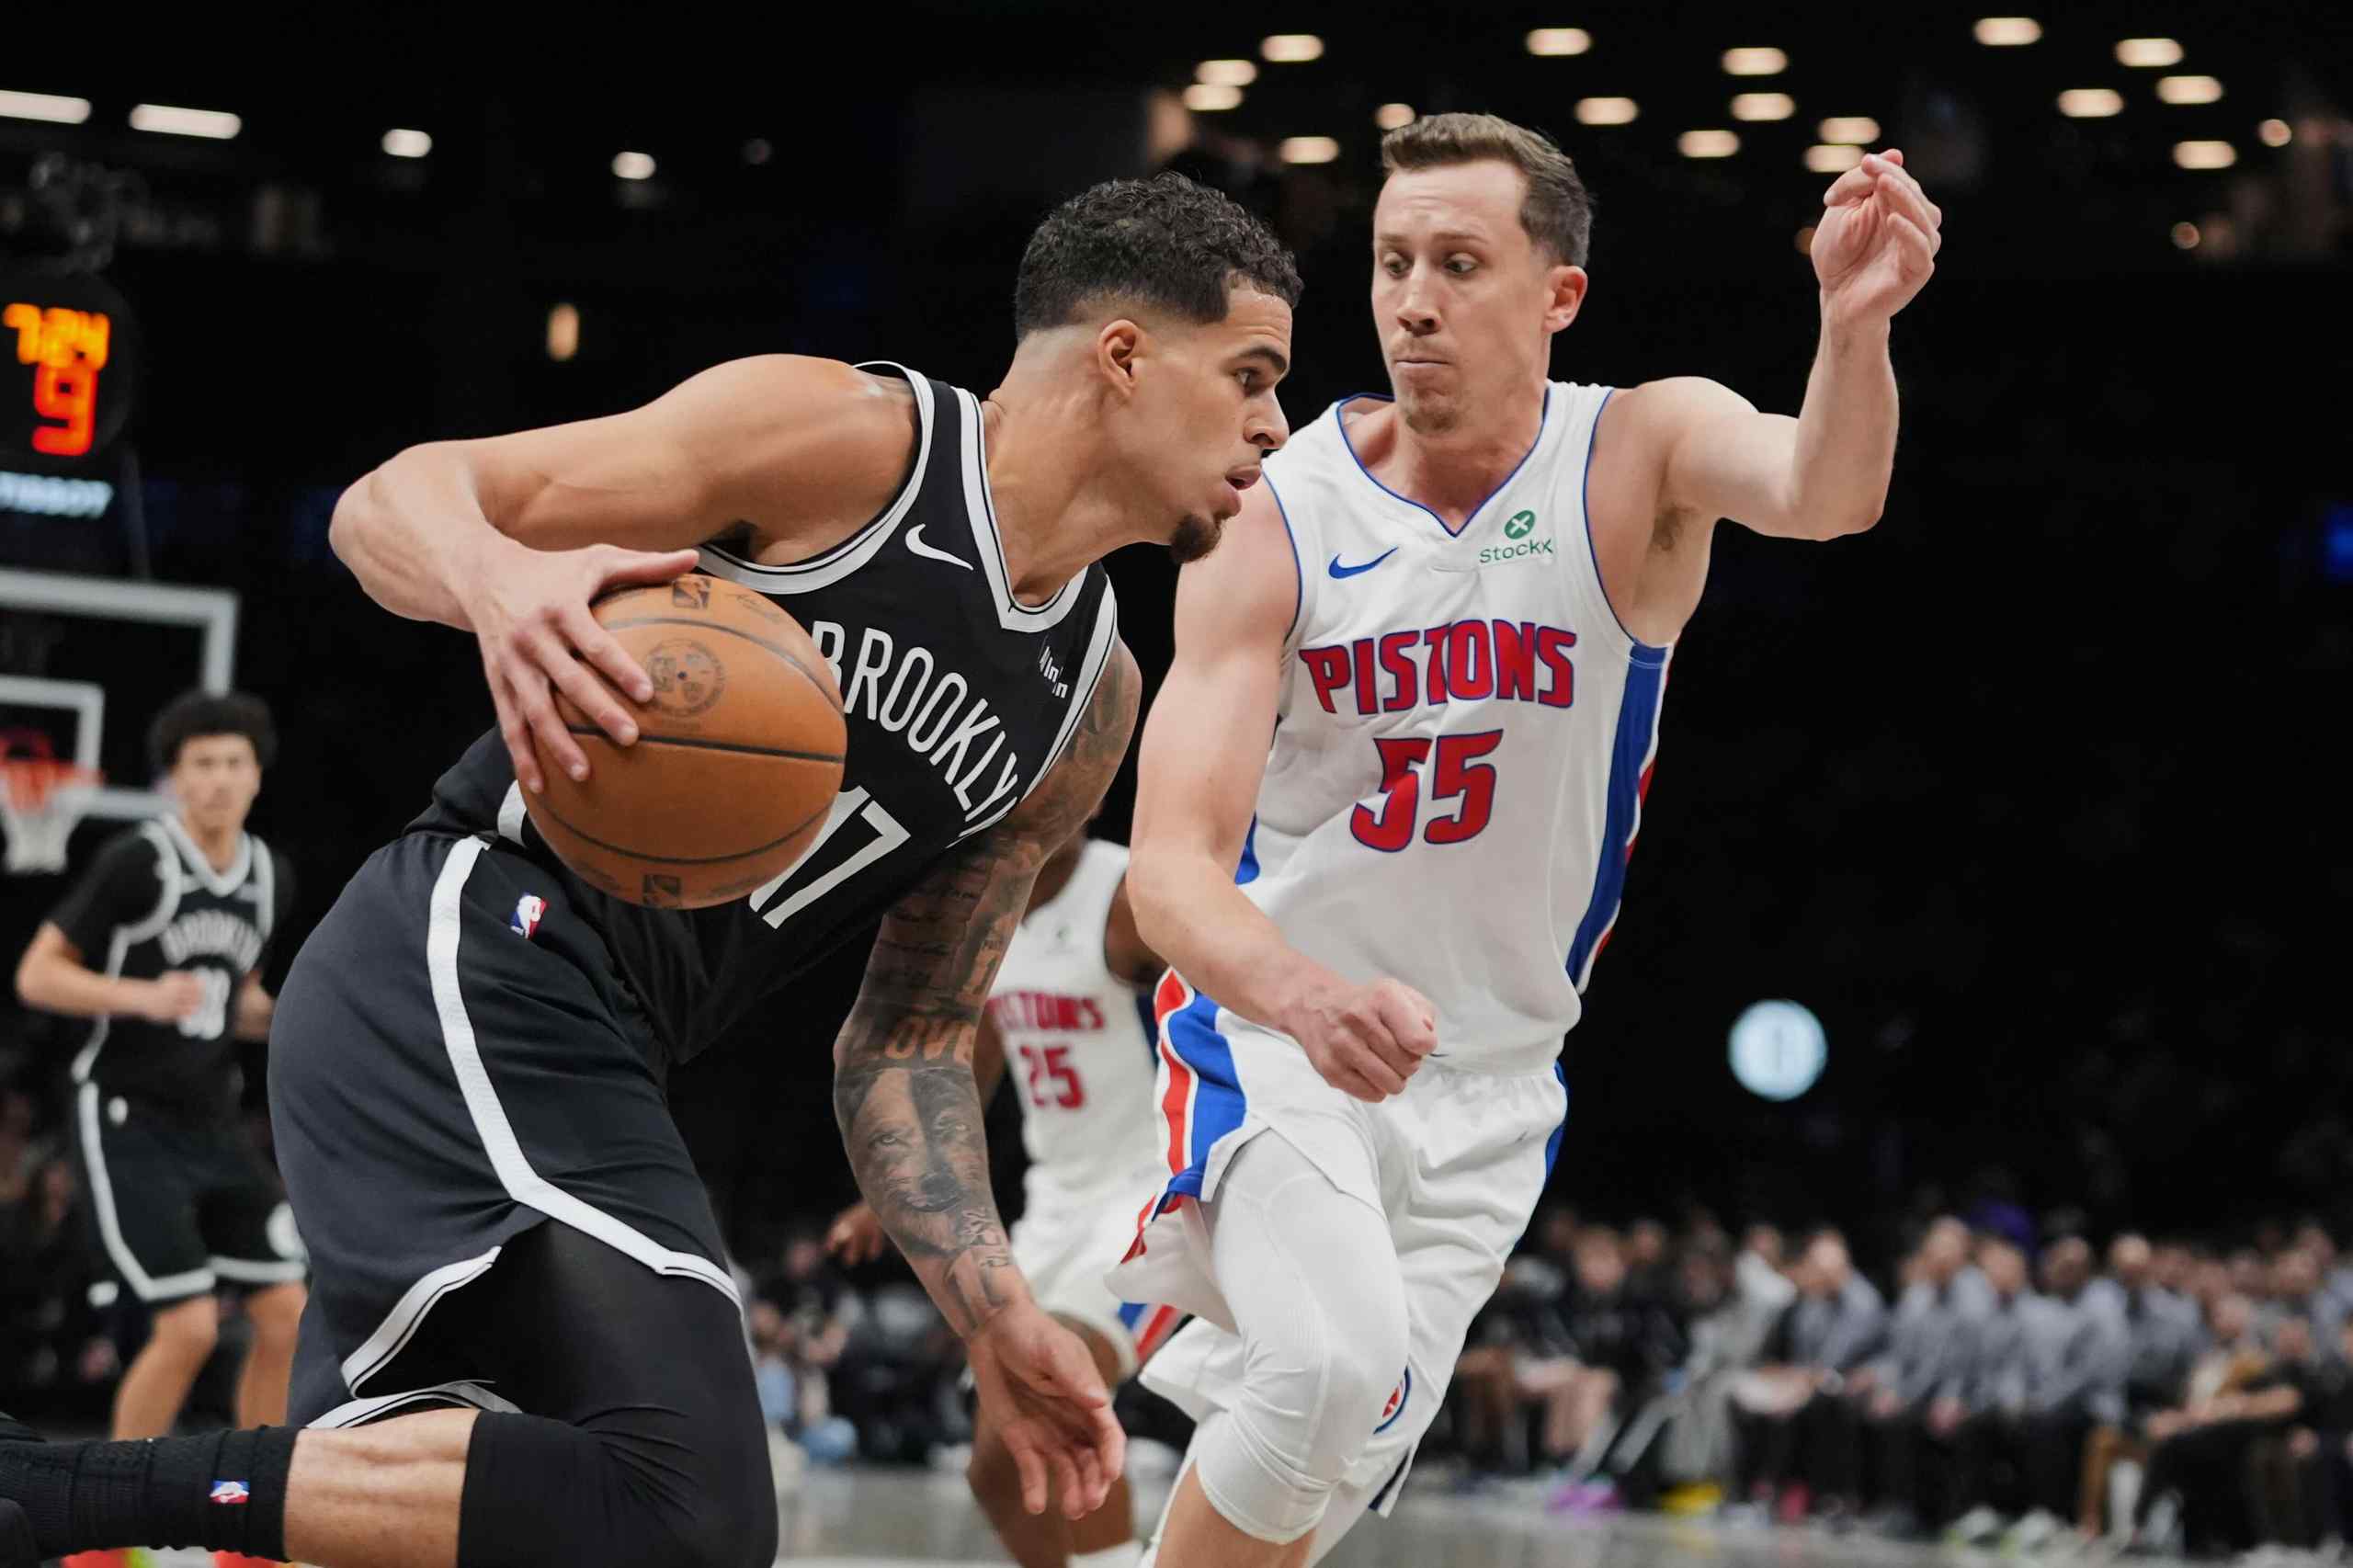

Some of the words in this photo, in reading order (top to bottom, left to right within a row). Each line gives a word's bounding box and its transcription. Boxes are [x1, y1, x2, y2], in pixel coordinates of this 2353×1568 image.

[1298, 619, 1577, 715] PISTONS
[813, 619, 1017, 848] BROOKLY
[1349, 729, 1504, 853] 55
[749, 785, 912, 929] 17
[1017, 1044, 1086, 1109] 25
